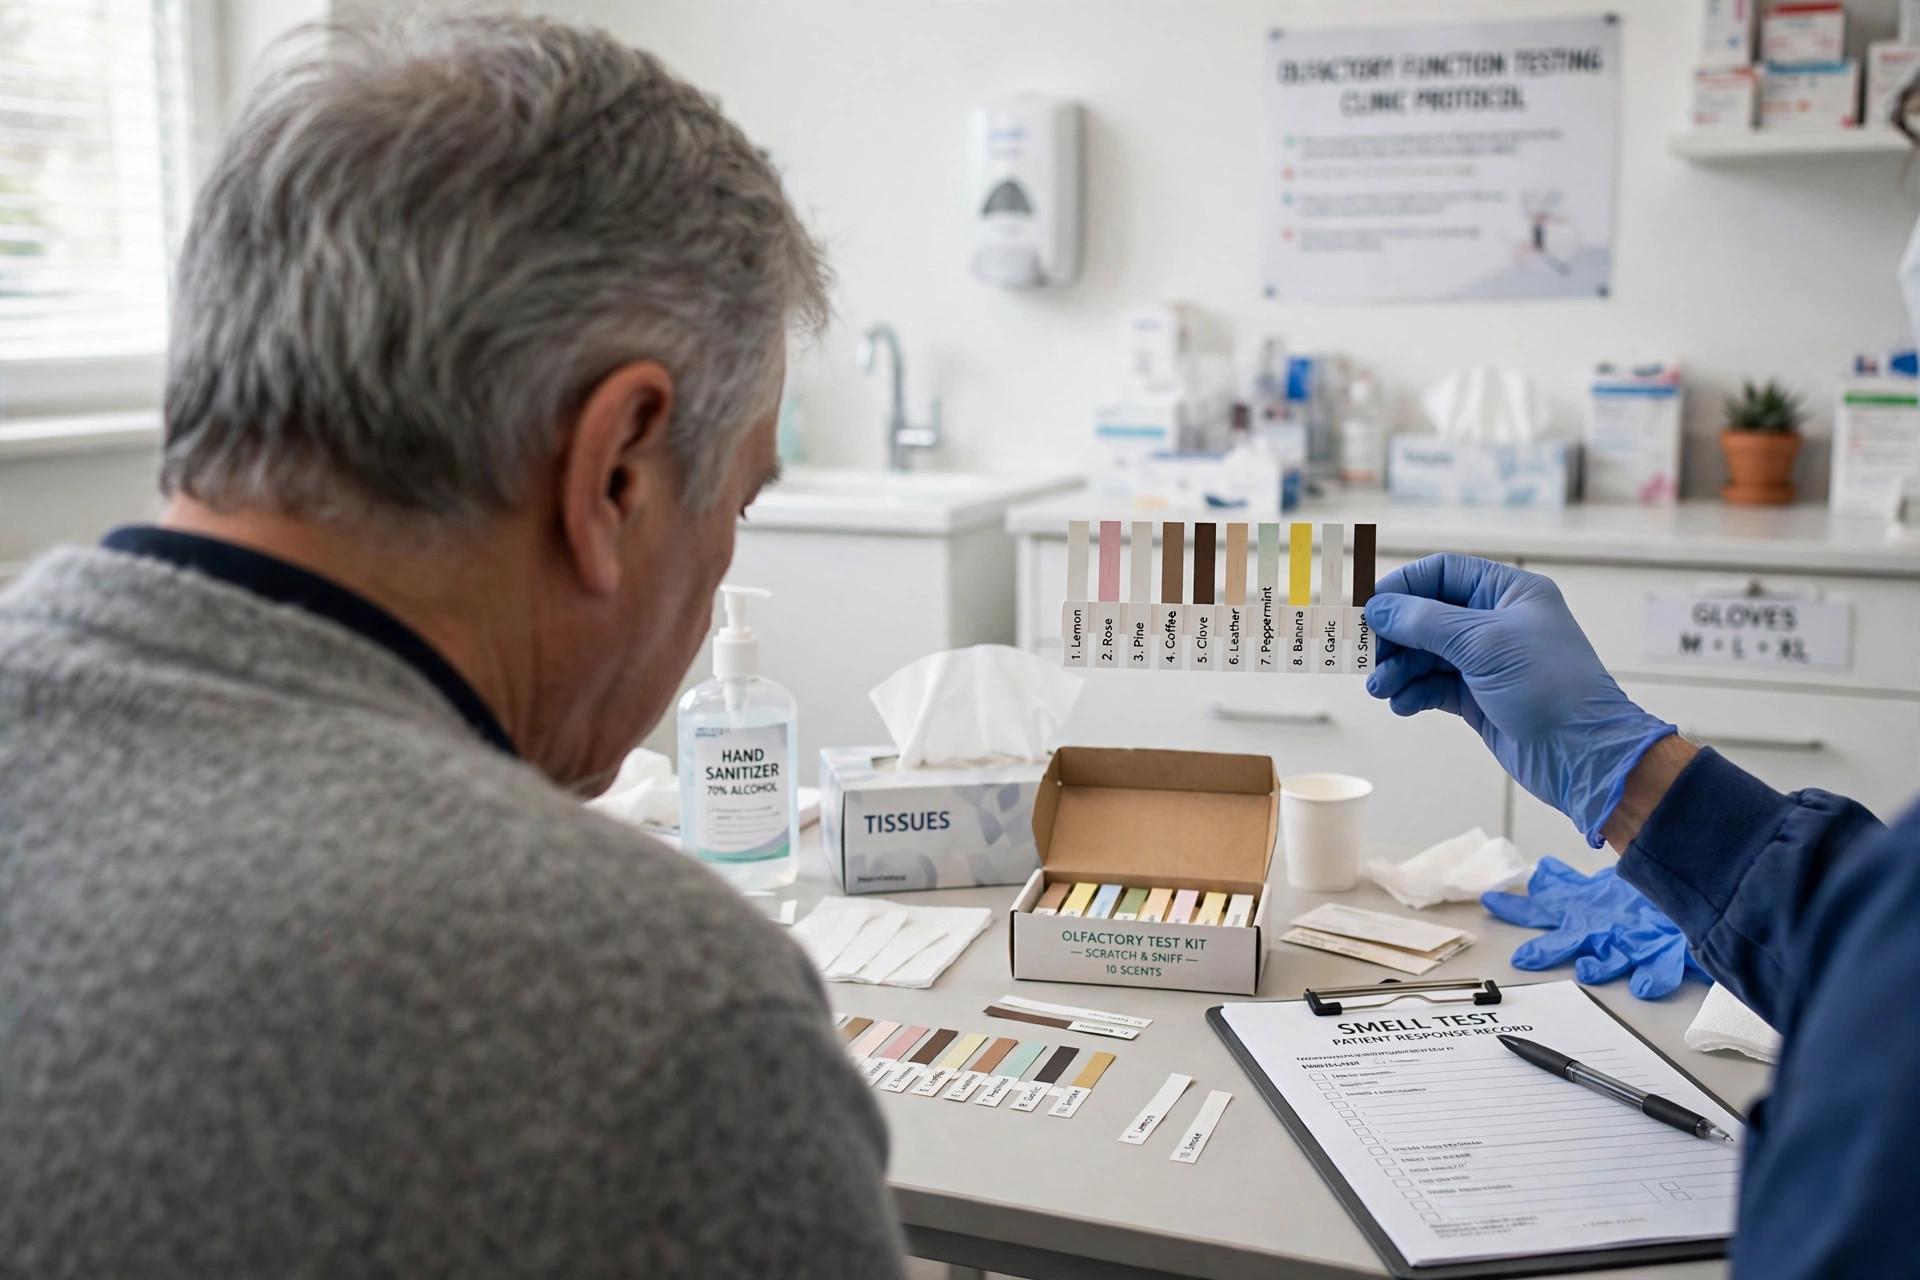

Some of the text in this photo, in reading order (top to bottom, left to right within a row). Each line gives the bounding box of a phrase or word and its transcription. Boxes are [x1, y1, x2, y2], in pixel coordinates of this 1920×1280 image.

[1277, 47, 1602, 85] OLFACTORY FUNCTION TESTING
[1341, 83, 1527, 116] CLINIC PROTOCOL
[1071, 609, 1081, 648] Lemon
[1165, 610, 1177, 649] Coffee
[1229, 608, 1240, 652] Leather
[1260, 586, 1274, 653] Peppermint
[1691, 602, 1798, 632] GLOVES
[1102, 618, 1113, 646] Rose
[1133, 622, 1144, 648] Pine
[1196, 616, 1208, 649] Clove
[1324, 620, 1336, 653] Garlic
[1679, 631, 1812, 664] M L XL
[722, 748, 765, 763] HAND
[706, 762, 780, 781] SANITIZER
[706, 782, 778, 796] 70% ALCOHOL
[864, 810, 951, 835] TISSUES
[1061, 930, 1208, 951] OLFACTORY TEST KIT
[1085, 948, 1184, 965] SCRATCH & SNIFF
[1105, 964, 1163, 978] 10 SCENTS
[1332, 1024, 1535, 1047] PATIENT RESPONSE RECORD
[1337, 1012, 1501, 1035] SMELL TEST
